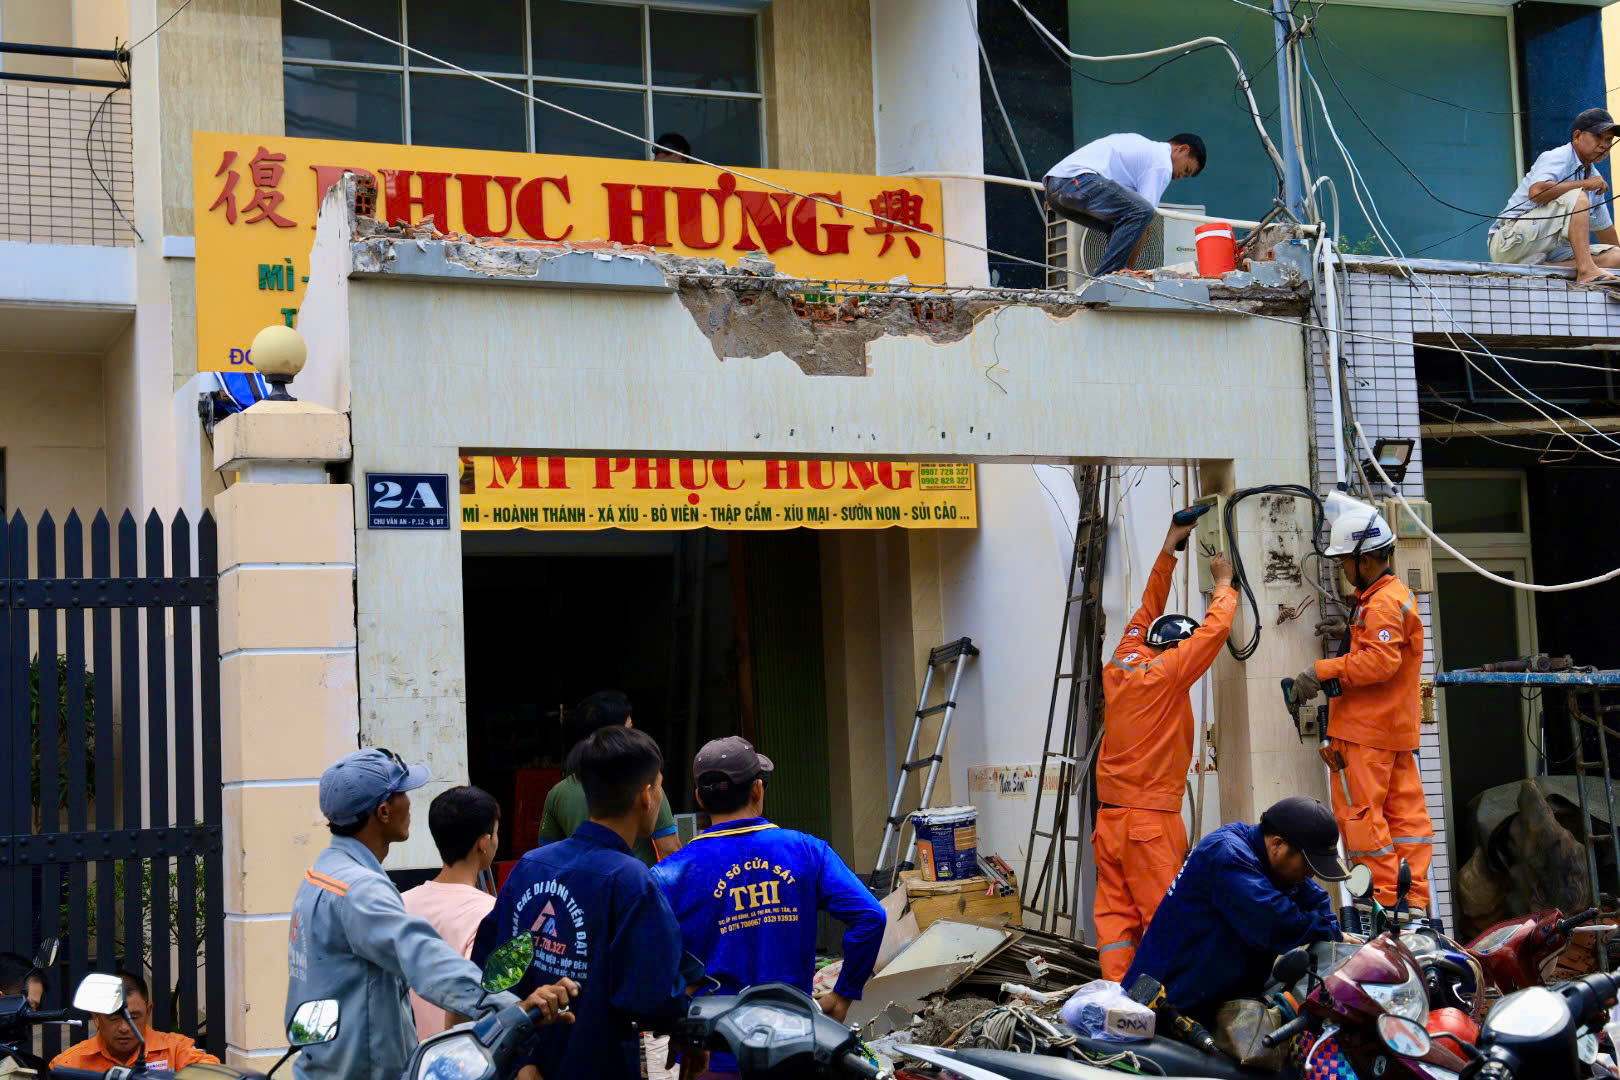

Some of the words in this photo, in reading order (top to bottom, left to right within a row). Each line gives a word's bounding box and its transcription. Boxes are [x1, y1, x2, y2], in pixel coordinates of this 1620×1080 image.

[209, 146, 298, 228] 復
[864, 188, 934, 258] 興
[258, 257, 295, 291] MÌ
[373, 481, 444, 509] 2A
[463, 504, 479, 523] MÌ
[493, 504, 538, 523] HOÀNH
[542, 504, 586, 523] THÁNH
[598, 504, 613, 523] XÁ
[618, 504, 640, 523] XÍU
[651, 504, 668, 523] BÒ
[671, 504, 699, 522] VIÊN
[711, 504, 741, 525] THẬP
[784, 503, 803, 522] XÍU
[807, 507, 830, 525] MẠI
[841, 502, 873, 521] SƯỜN
[876, 506, 901, 521] NON
[912, 501, 931, 520] SỦI
[936, 501, 957, 520] CẢO
[516, 888, 533, 912] CHE
[534, 880, 544, 895] DI
[566, 897, 584, 928] TIẾN
[730, 880, 780, 911] THI
